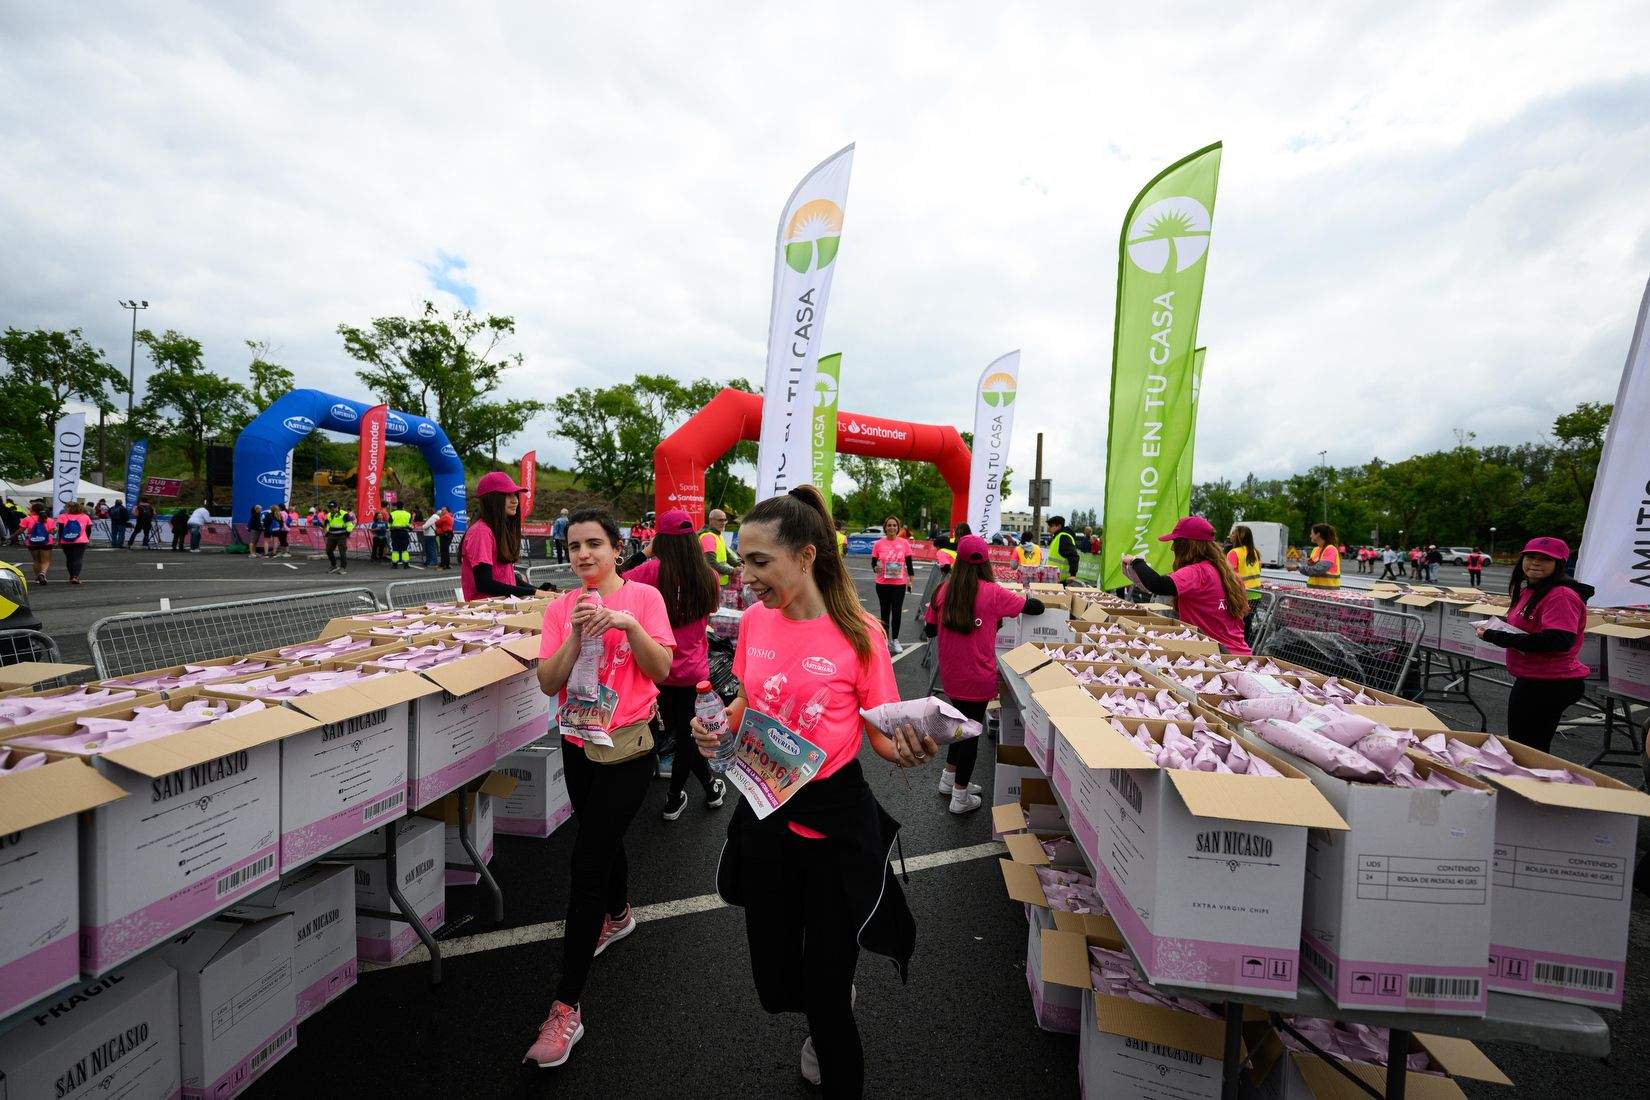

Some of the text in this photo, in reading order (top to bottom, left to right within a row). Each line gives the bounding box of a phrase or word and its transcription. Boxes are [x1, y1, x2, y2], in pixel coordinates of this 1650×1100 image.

[792, 288, 815, 358] CASA
[1149, 290, 1175, 366] CASA
[1144, 374, 1168, 413] TU
[814, 414, 826, 447] CASA
[860, 423, 907, 441] Santander
[1142, 421, 1163, 457] EN
[58, 431, 81, 505] OYSHO
[366, 420, 380, 516] Sports Santander
[813, 452, 824, 471] TU
[979, 415, 1002, 540] AMUTIO EN TU CASA
[149, 479, 166, 487] SUB
[679, 483, 699, 492] Sports
[747, 646, 776, 660] OYSHO
[322, 708, 387, 742] SAN NICASIO
[768, 730, 798, 755] ASTURIANA
[152, 750, 249, 802] SAN NICASIO
[1196, 831, 1273, 858] SAN NICASIO
[1437, 865, 1480, 873] CONTENIDO
[1525, 866, 1548, 874] BOLSA
[1561, 869, 1589, 878] PATATAS
[1568, 857, 1618, 869] CONTENIDO
[297, 908, 340, 942] SAN NICASIO
[1219, 904, 1246, 912] VIRGIN
[1249, 907, 1270, 915] CHIPS
[55, 1022, 149, 1099] SAN NICASIO
